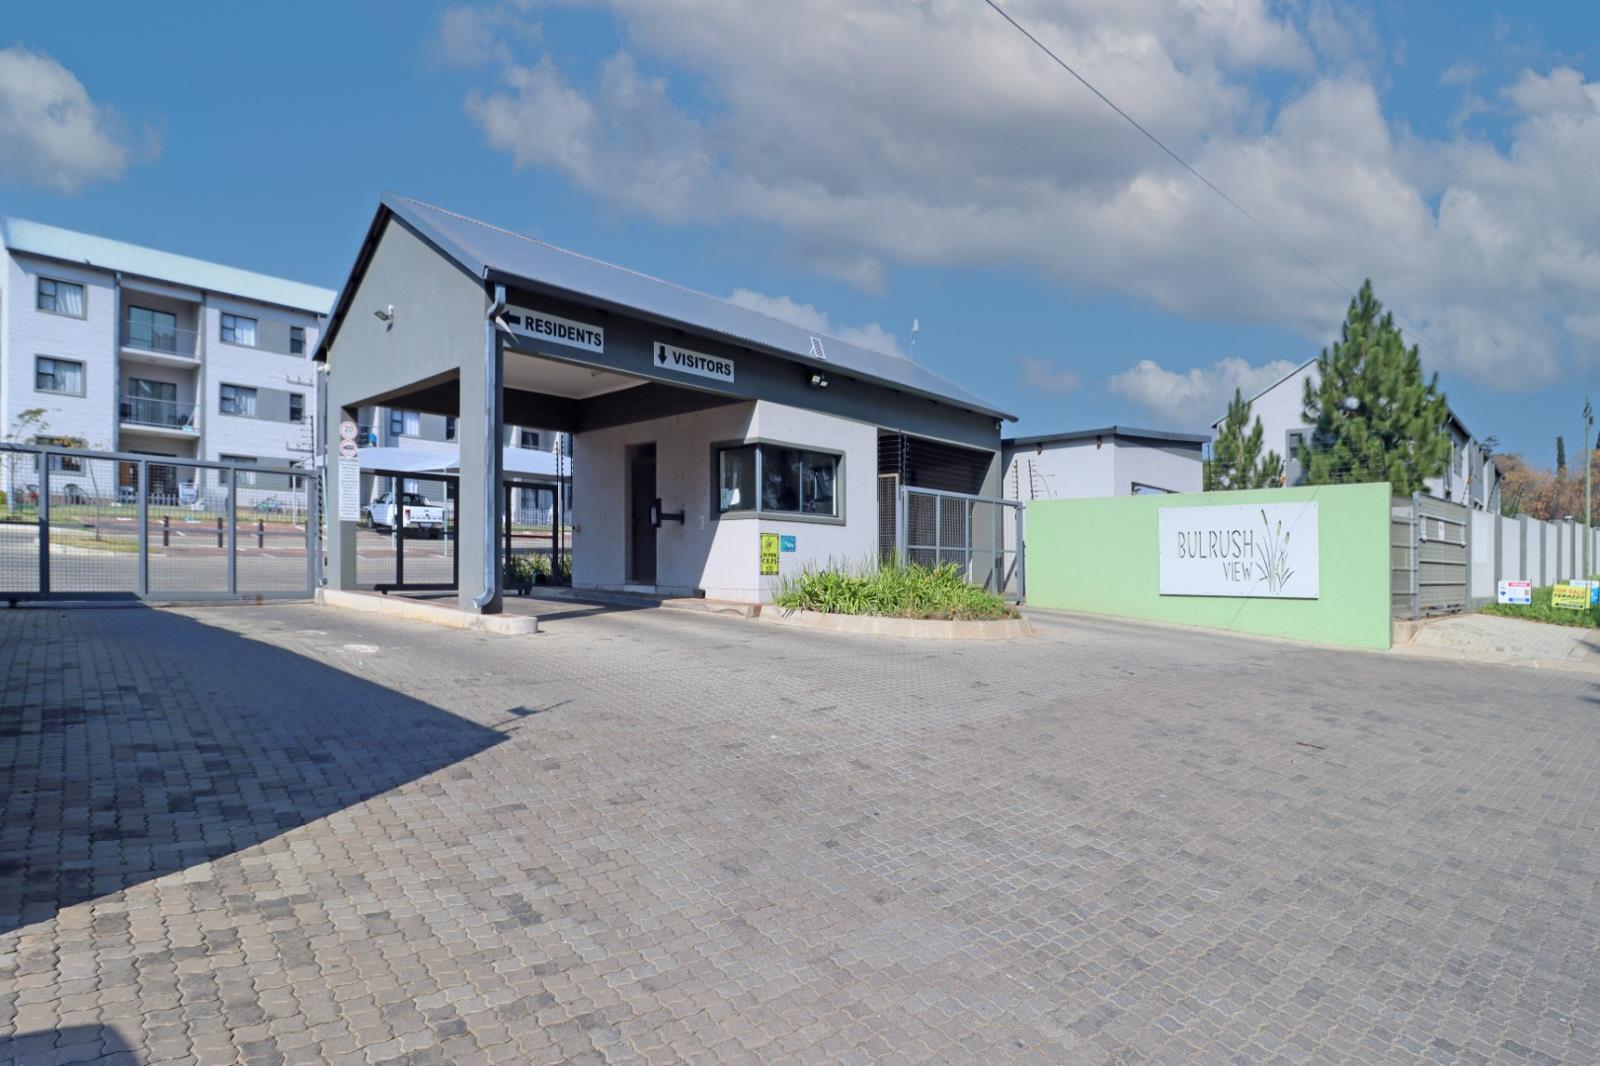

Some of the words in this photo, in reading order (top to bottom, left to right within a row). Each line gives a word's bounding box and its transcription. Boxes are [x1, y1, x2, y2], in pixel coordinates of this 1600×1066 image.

[524, 315, 602, 347] RESIDENTS
[672, 350, 732, 377] VISITORS
[1177, 529, 1254, 559] BULRUSH
[1222, 561, 1253, 583] VIEW
